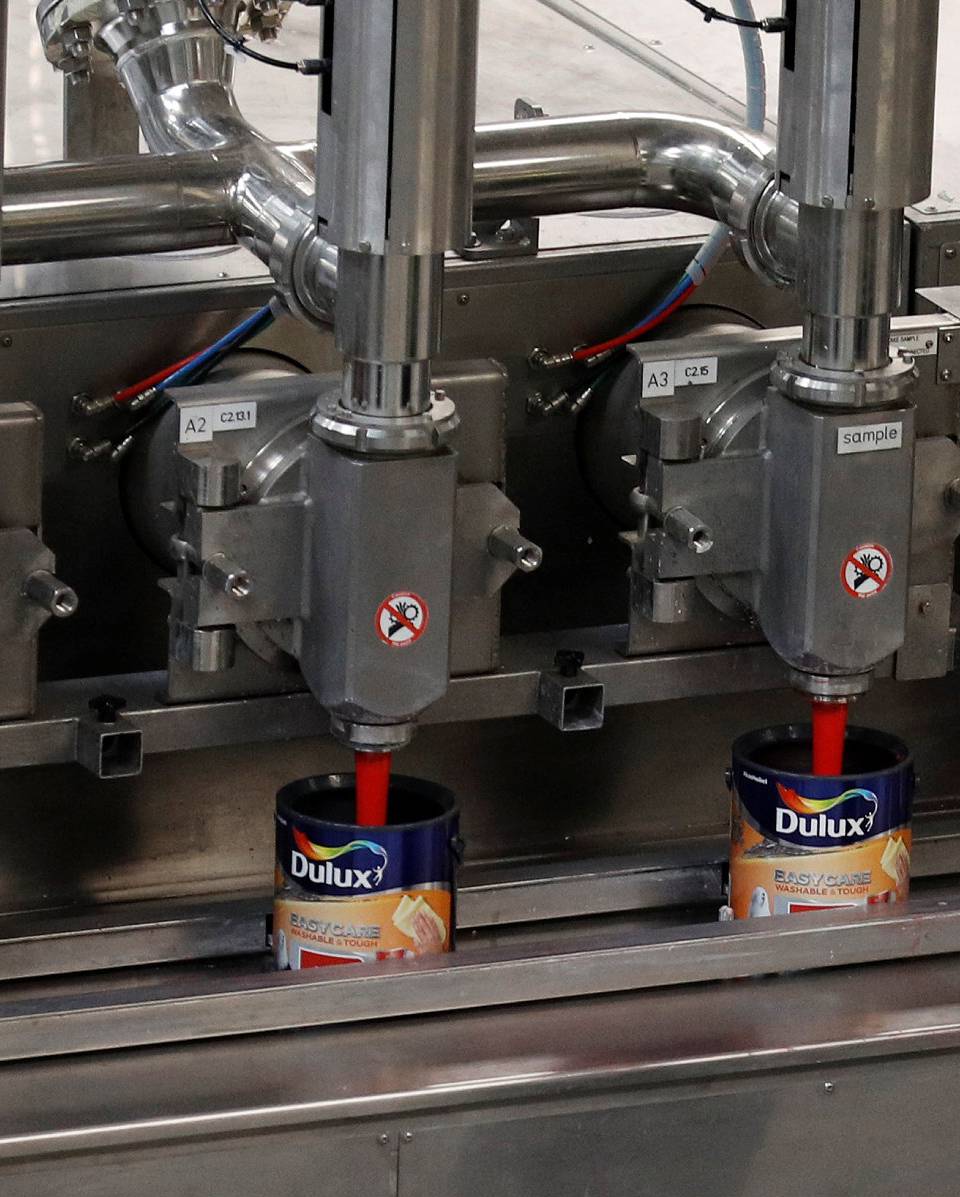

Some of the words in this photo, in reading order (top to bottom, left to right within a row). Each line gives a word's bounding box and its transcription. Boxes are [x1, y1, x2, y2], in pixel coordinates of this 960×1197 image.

[647, 371, 669, 388] A3
[184, 416, 206, 434] A2
[843, 426, 898, 445] sample
[776, 807, 865, 837] Dulux
[291, 850, 372, 889] Dulux
[775, 885, 828, 896] WASHABLE
[838, 886, 869, 895] TOUGH
[290, 928, 335, 945] WASHABLE
[344, 939, 379, 948] TOUGH
